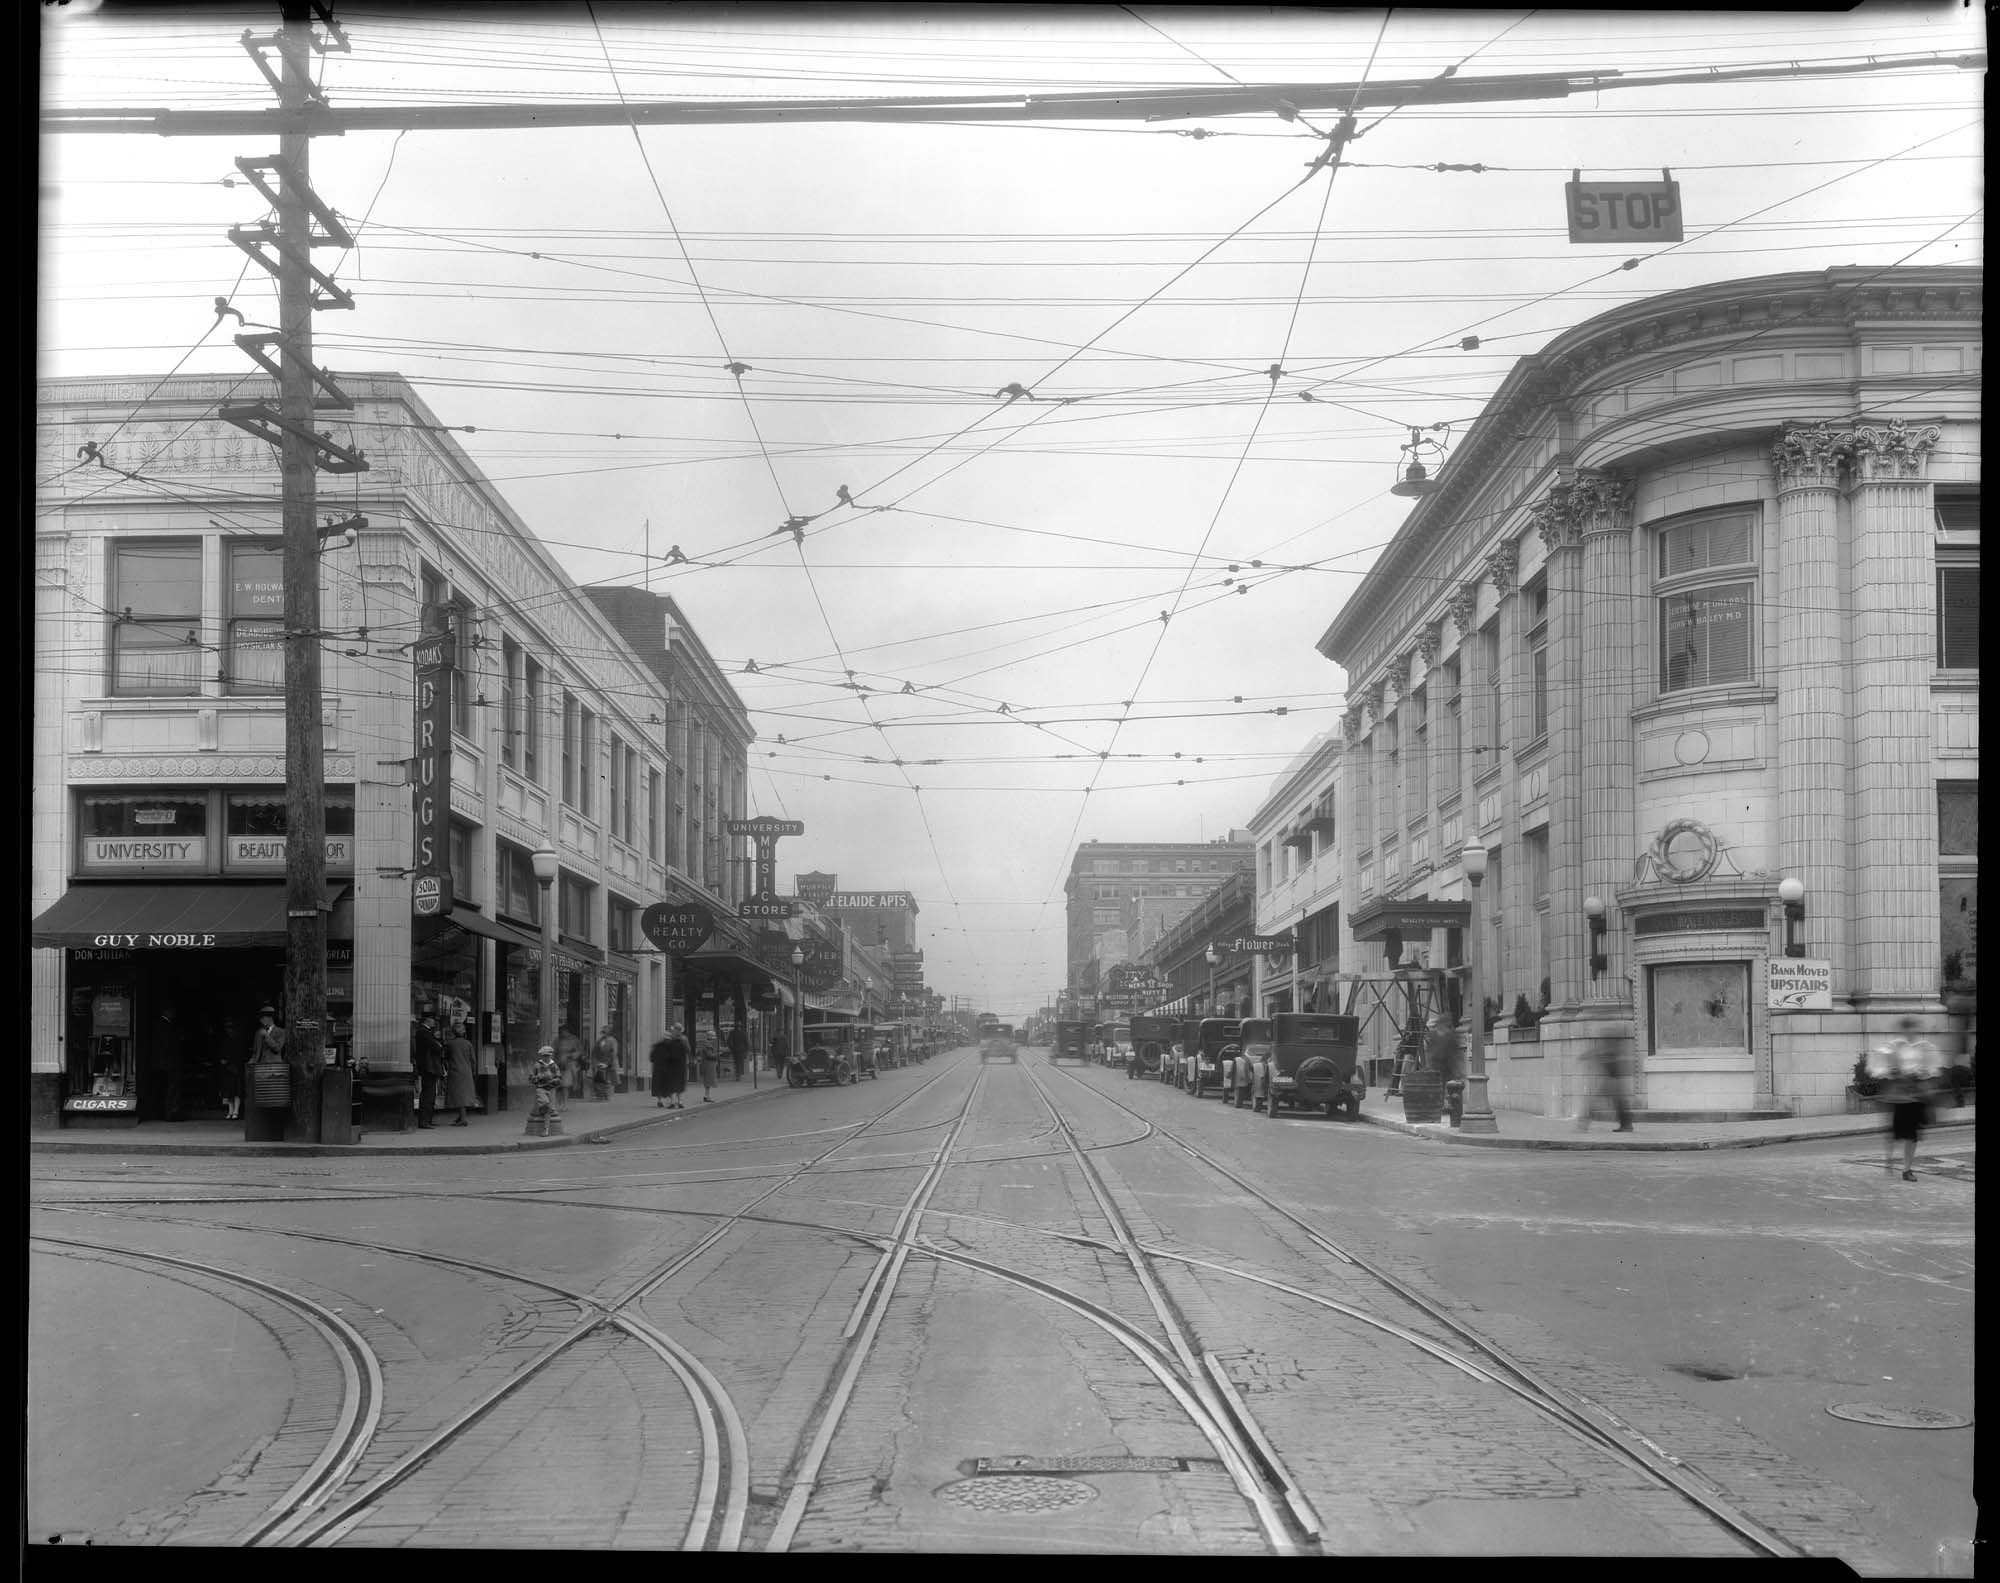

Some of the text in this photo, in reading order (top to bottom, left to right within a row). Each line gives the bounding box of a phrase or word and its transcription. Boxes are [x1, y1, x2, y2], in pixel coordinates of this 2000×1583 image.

[1575, 193, 1676, 230] STOP
[421, 680, 435, 866] DRUGS
[733, 824, 798, 832] UNIVERSITY
[96, 842, 192, 860] UNIVERSITY
[760, 835, 771, 902] MUSIC
[743, 904, 789, 915] STORE
[659, 913, 697, 924] HART
[652, 927, 704, 937] REALTY
[94, 934, 216, 947] GUY NOBLE
[668, 939, 691, 950] CO.
[1230, 937, 1275, 953] Flower
[1770, 963, 1829, 977] BANK MOVED
[1770, 979, 1829, 992] UPSTAIRS
[73, 1100, 129, 1110] CIGARS
